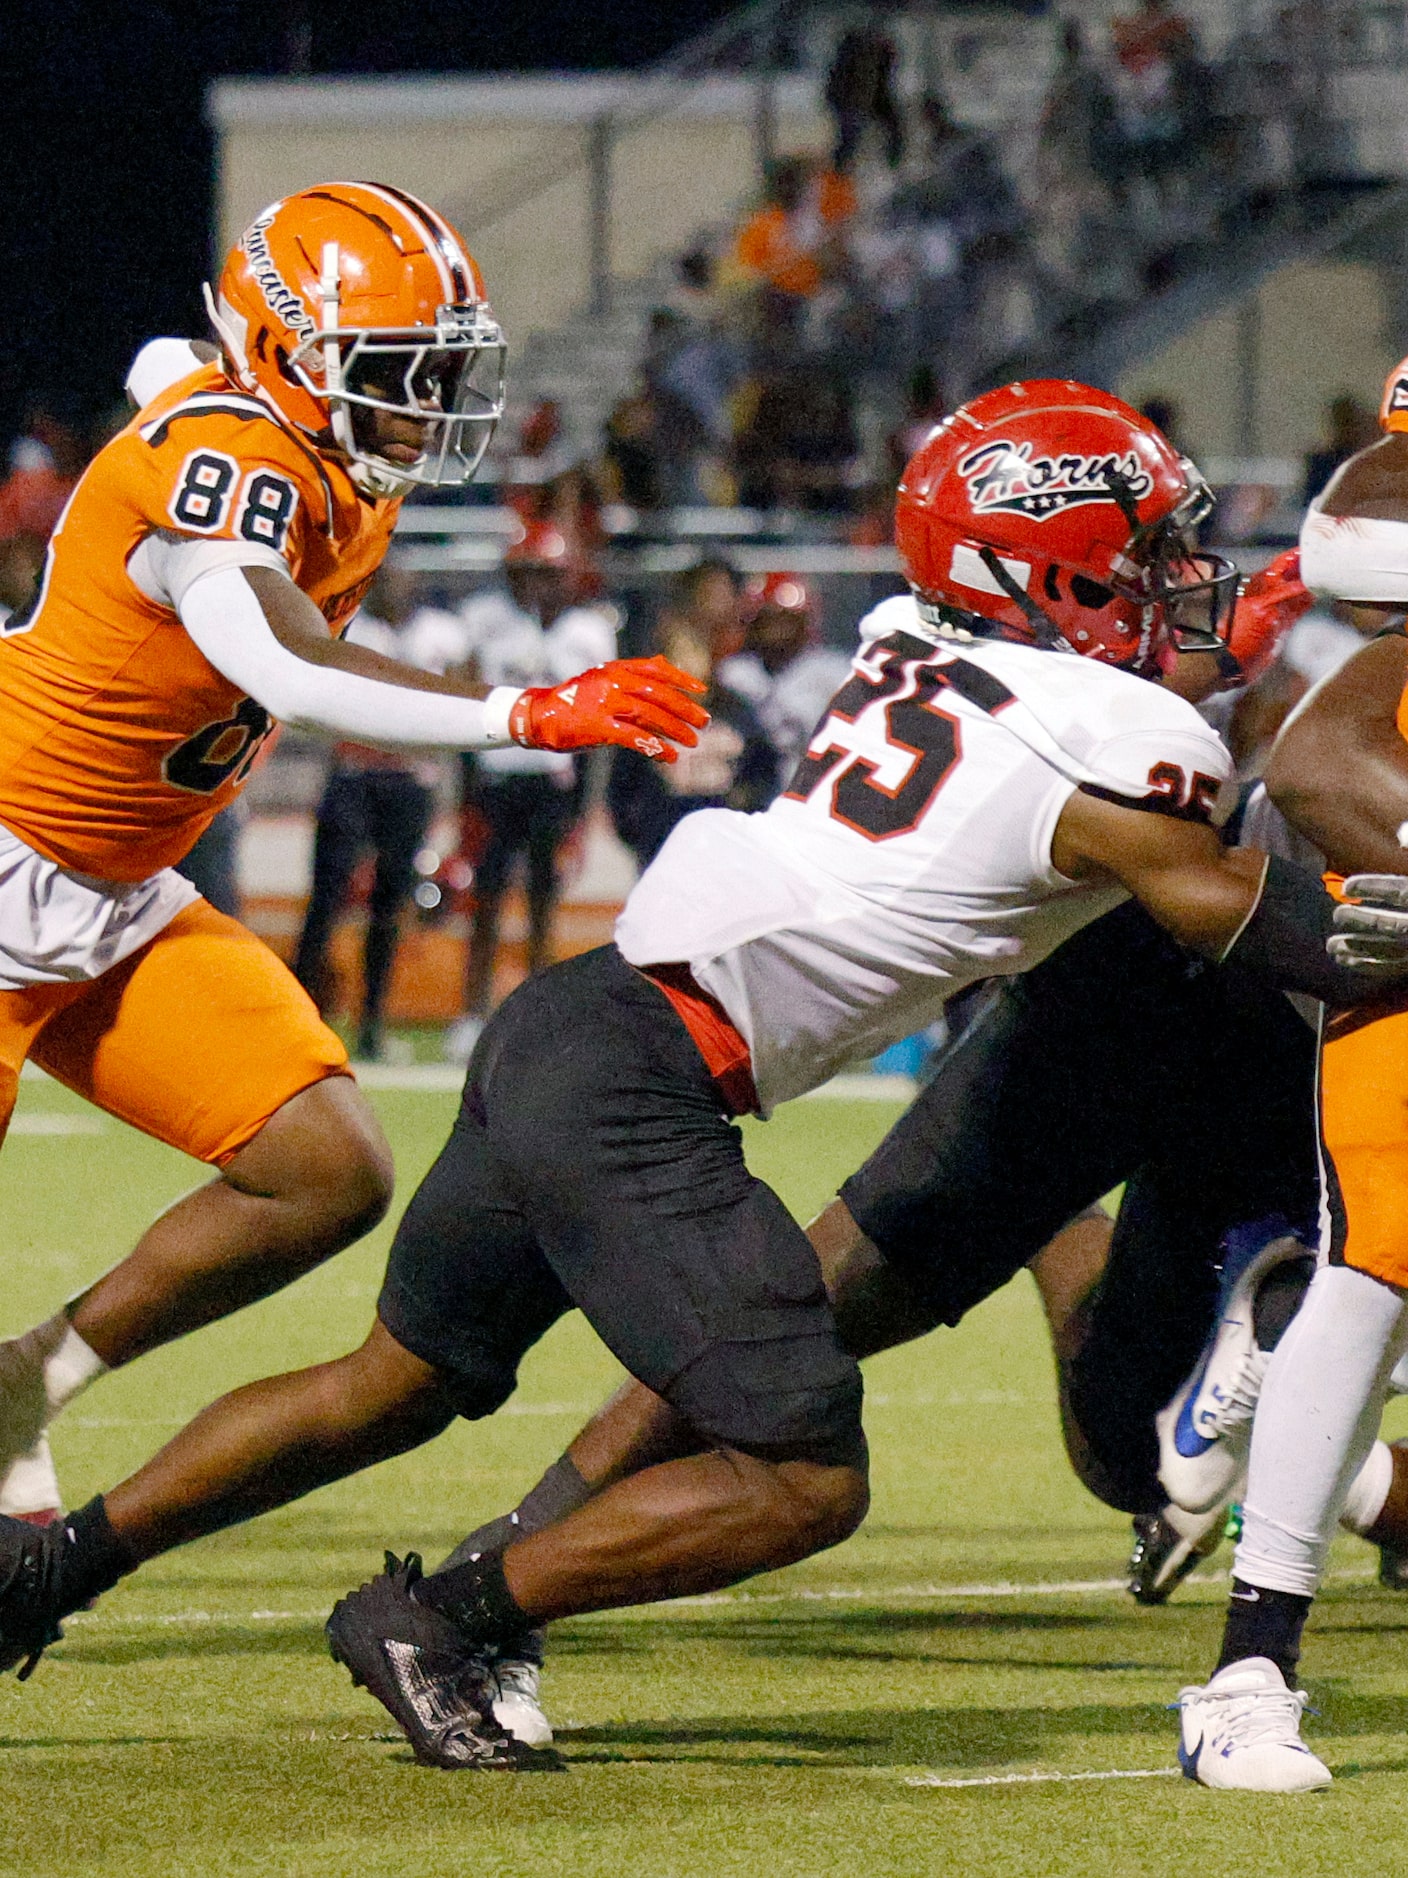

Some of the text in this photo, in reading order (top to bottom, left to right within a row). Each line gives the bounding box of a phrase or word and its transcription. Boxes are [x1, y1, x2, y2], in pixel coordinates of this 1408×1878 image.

[167, 447, 300, 551] 88
[957, 439, 1154, 503] Horns
[783, 628, 1020, 844] 25
[1143, 760, 1223, 822] 25
